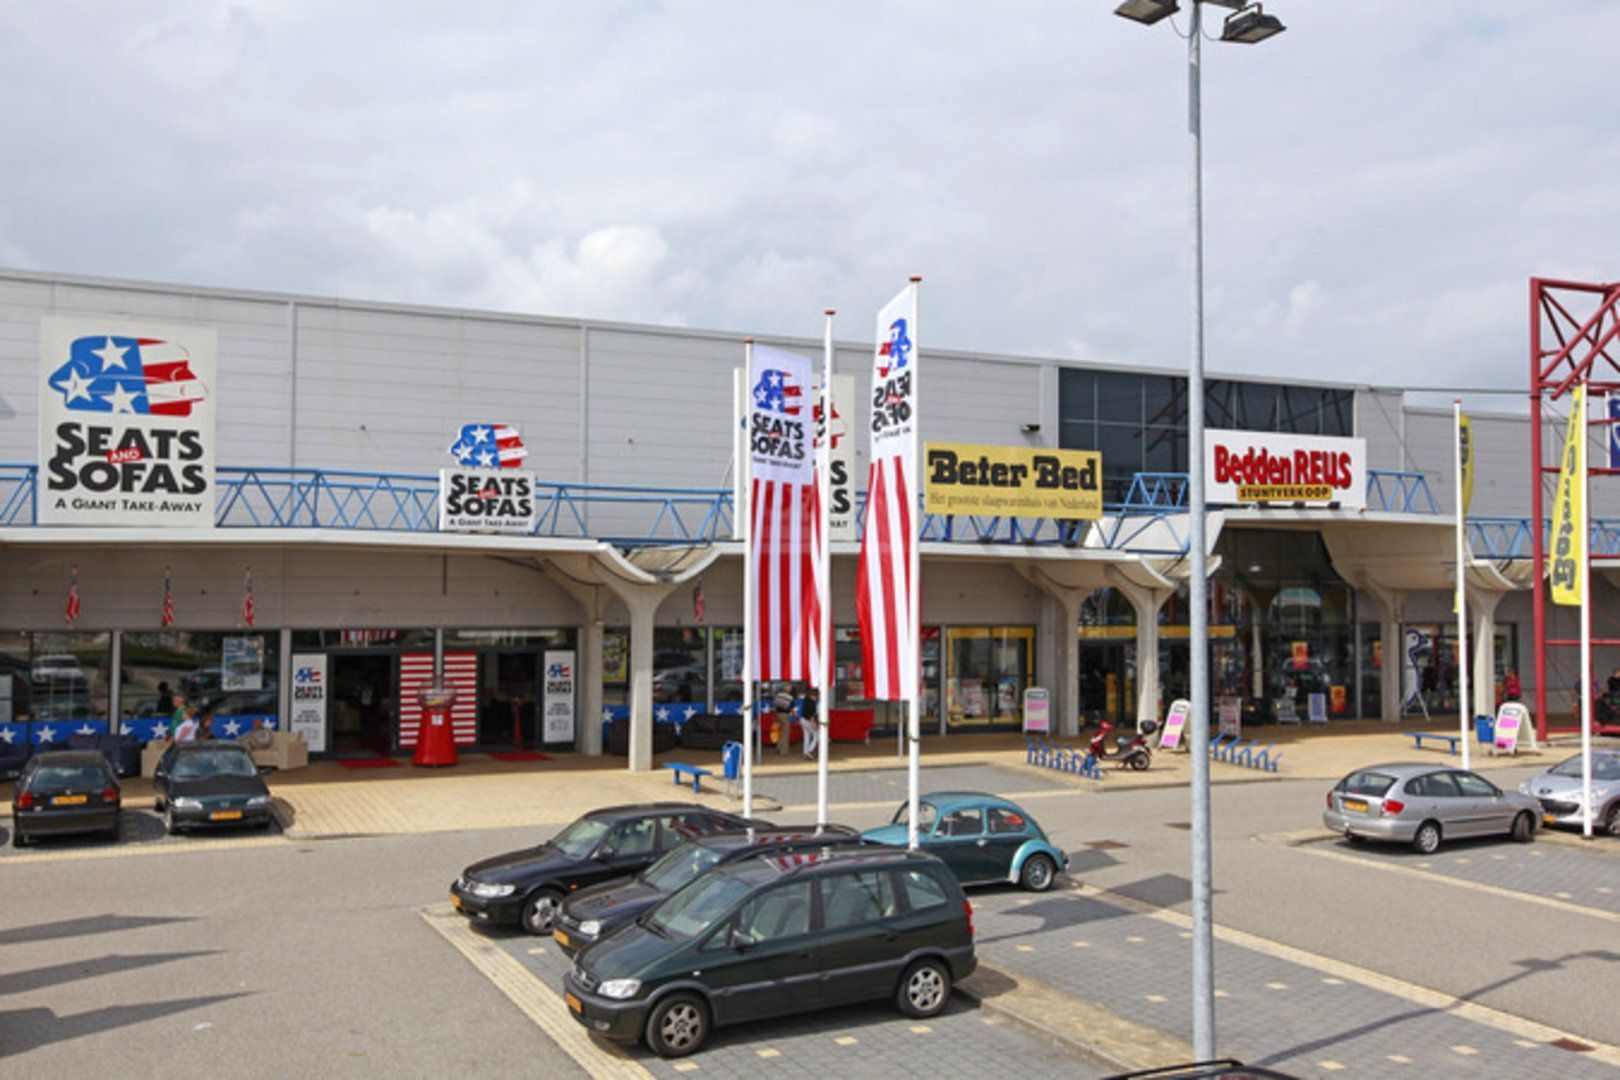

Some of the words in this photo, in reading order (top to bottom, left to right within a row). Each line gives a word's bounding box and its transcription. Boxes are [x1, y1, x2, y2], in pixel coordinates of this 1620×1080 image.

[752, 412, 805, 440] SEATS
[56, 422, 204, 460] SEATS
[110, 450, 141, 462] AND
[48, 456, 207, 494] SOFAS
[928, 450, 1028, 487] Beter
[1033, 455, 1098, 490] Bed
[451, 474, 530, 496] SEATS
[55, 498, 67, 509] A
[72, 498, 116, 510] GIANT
[122, 499, 202, 512] TAKE-AWAY
[447, 496, 532, 517] SOFAS
